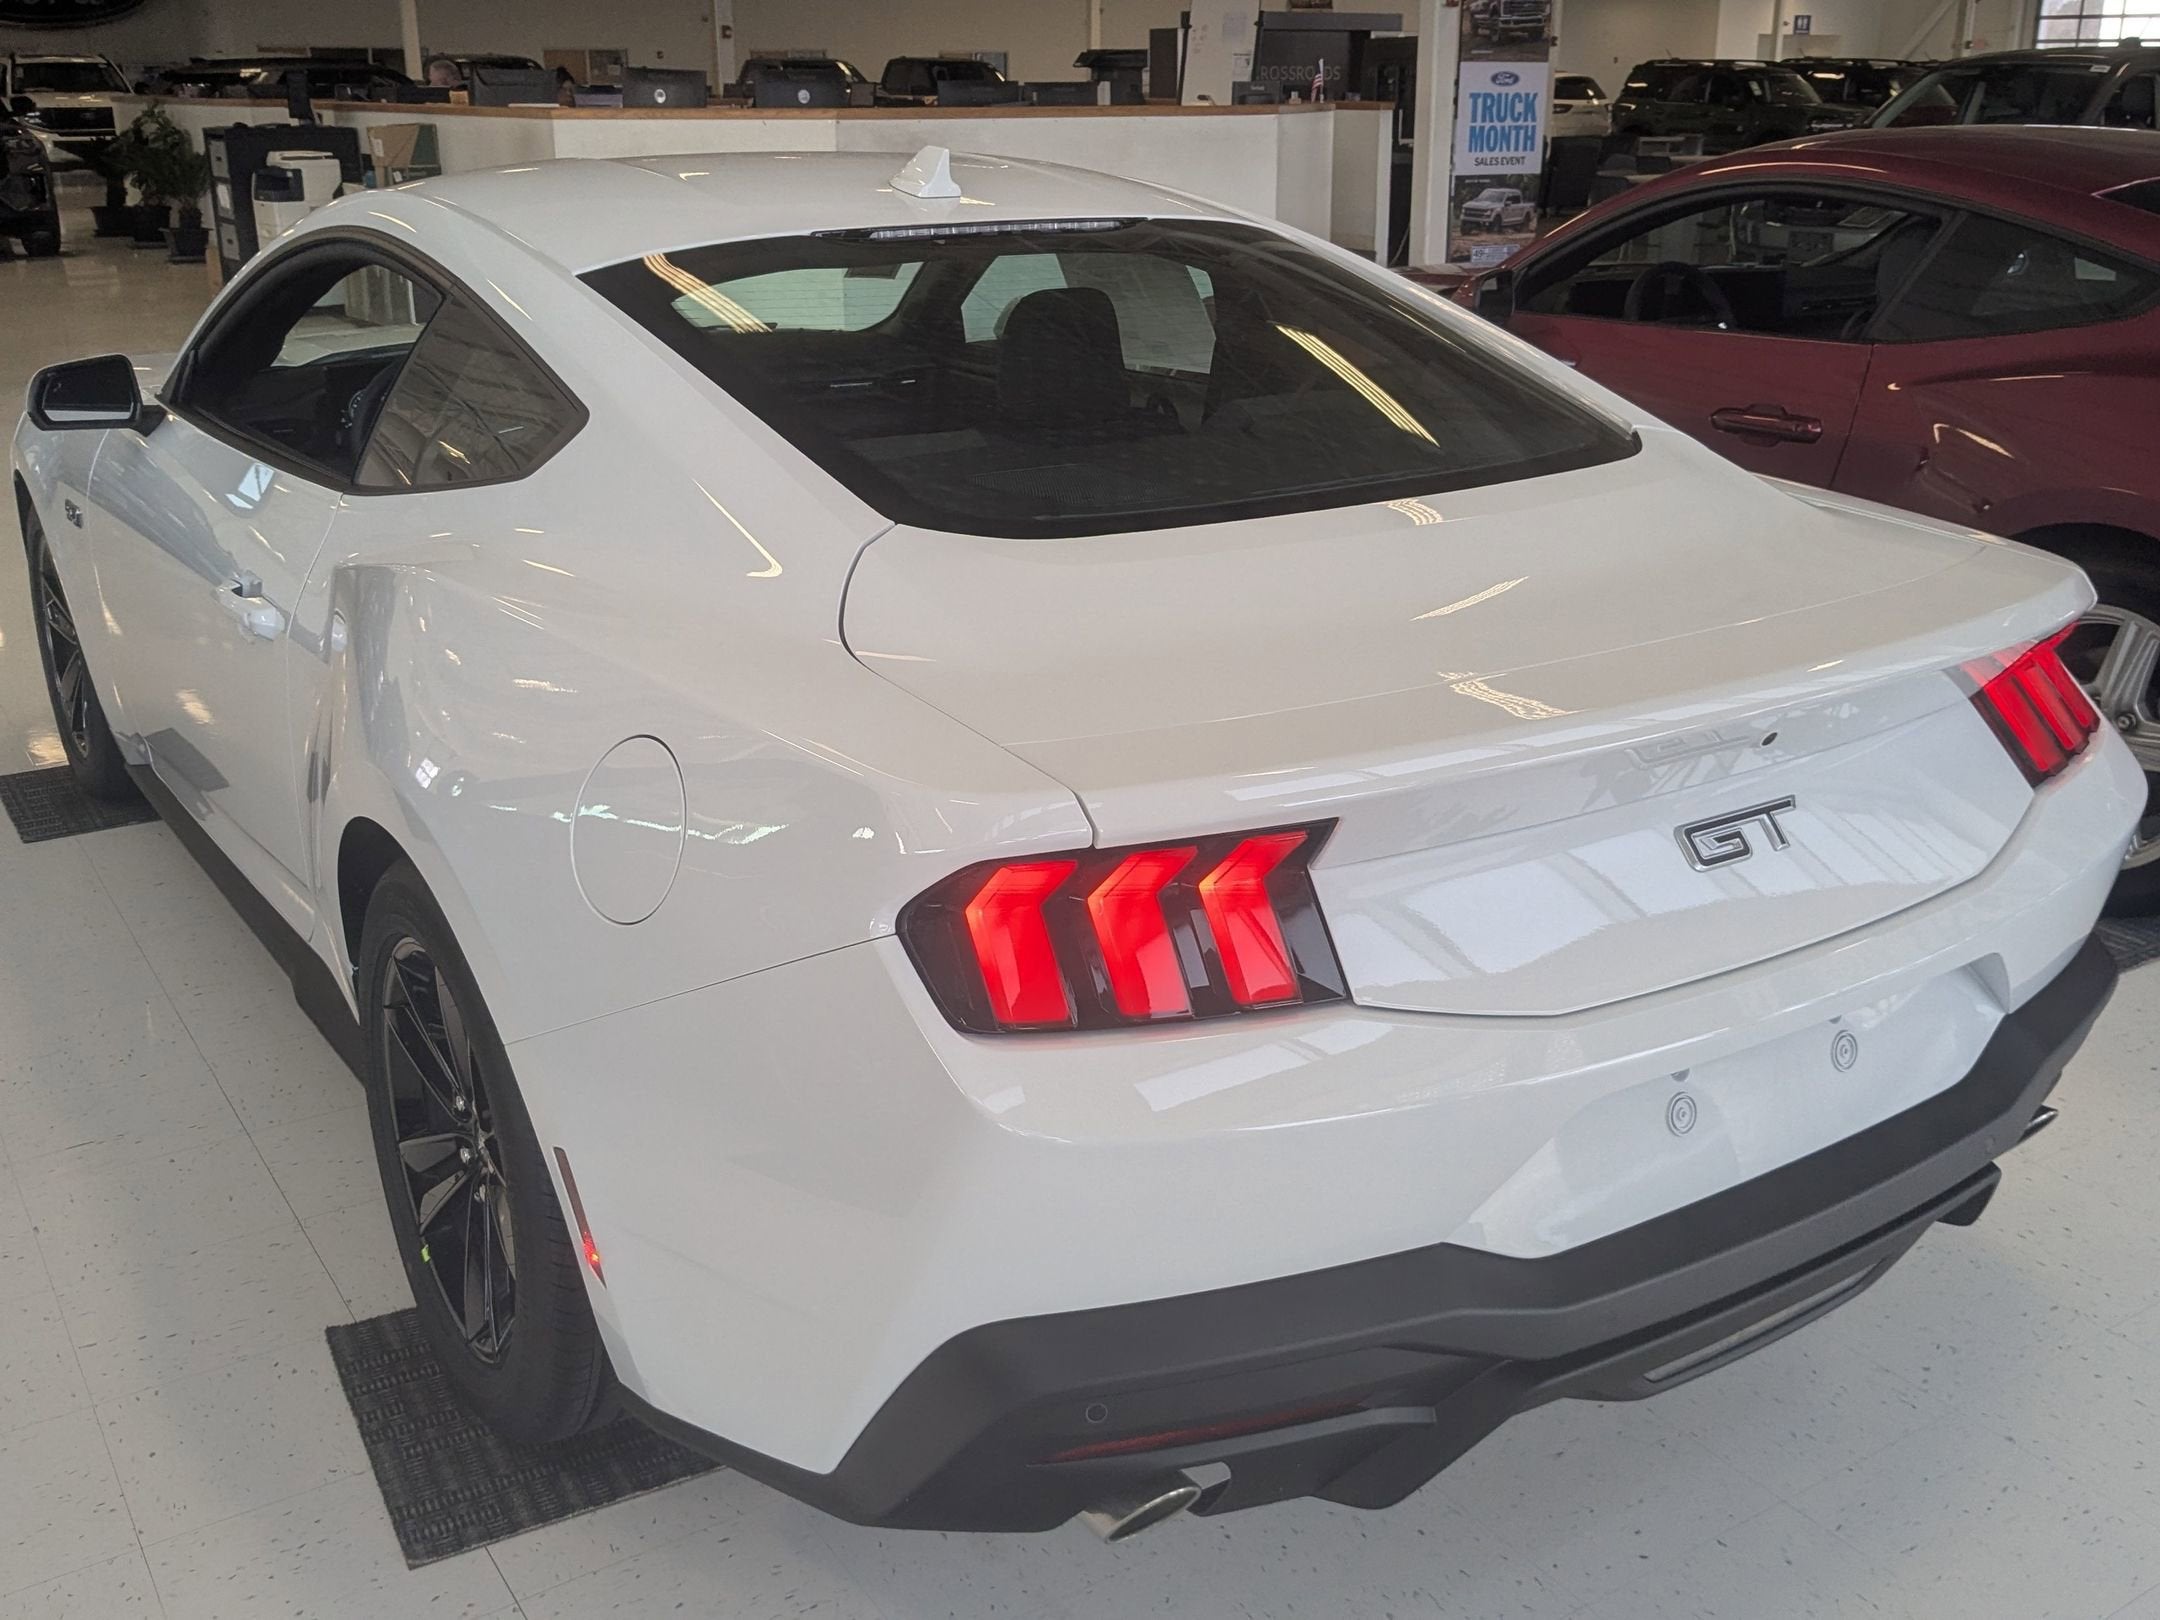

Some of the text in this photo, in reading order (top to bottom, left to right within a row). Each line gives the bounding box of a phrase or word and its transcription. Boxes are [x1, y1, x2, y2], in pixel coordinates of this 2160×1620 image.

[1256, 65, 1341, 81] ROSSRODS
[1469, 92, 1538, 123] TRUCK
[1468, 125, 1537, 153] MONTH
[1474, 156, 1526, 166] SALES EVENT
[1673, 794, 1797, 873] GT
